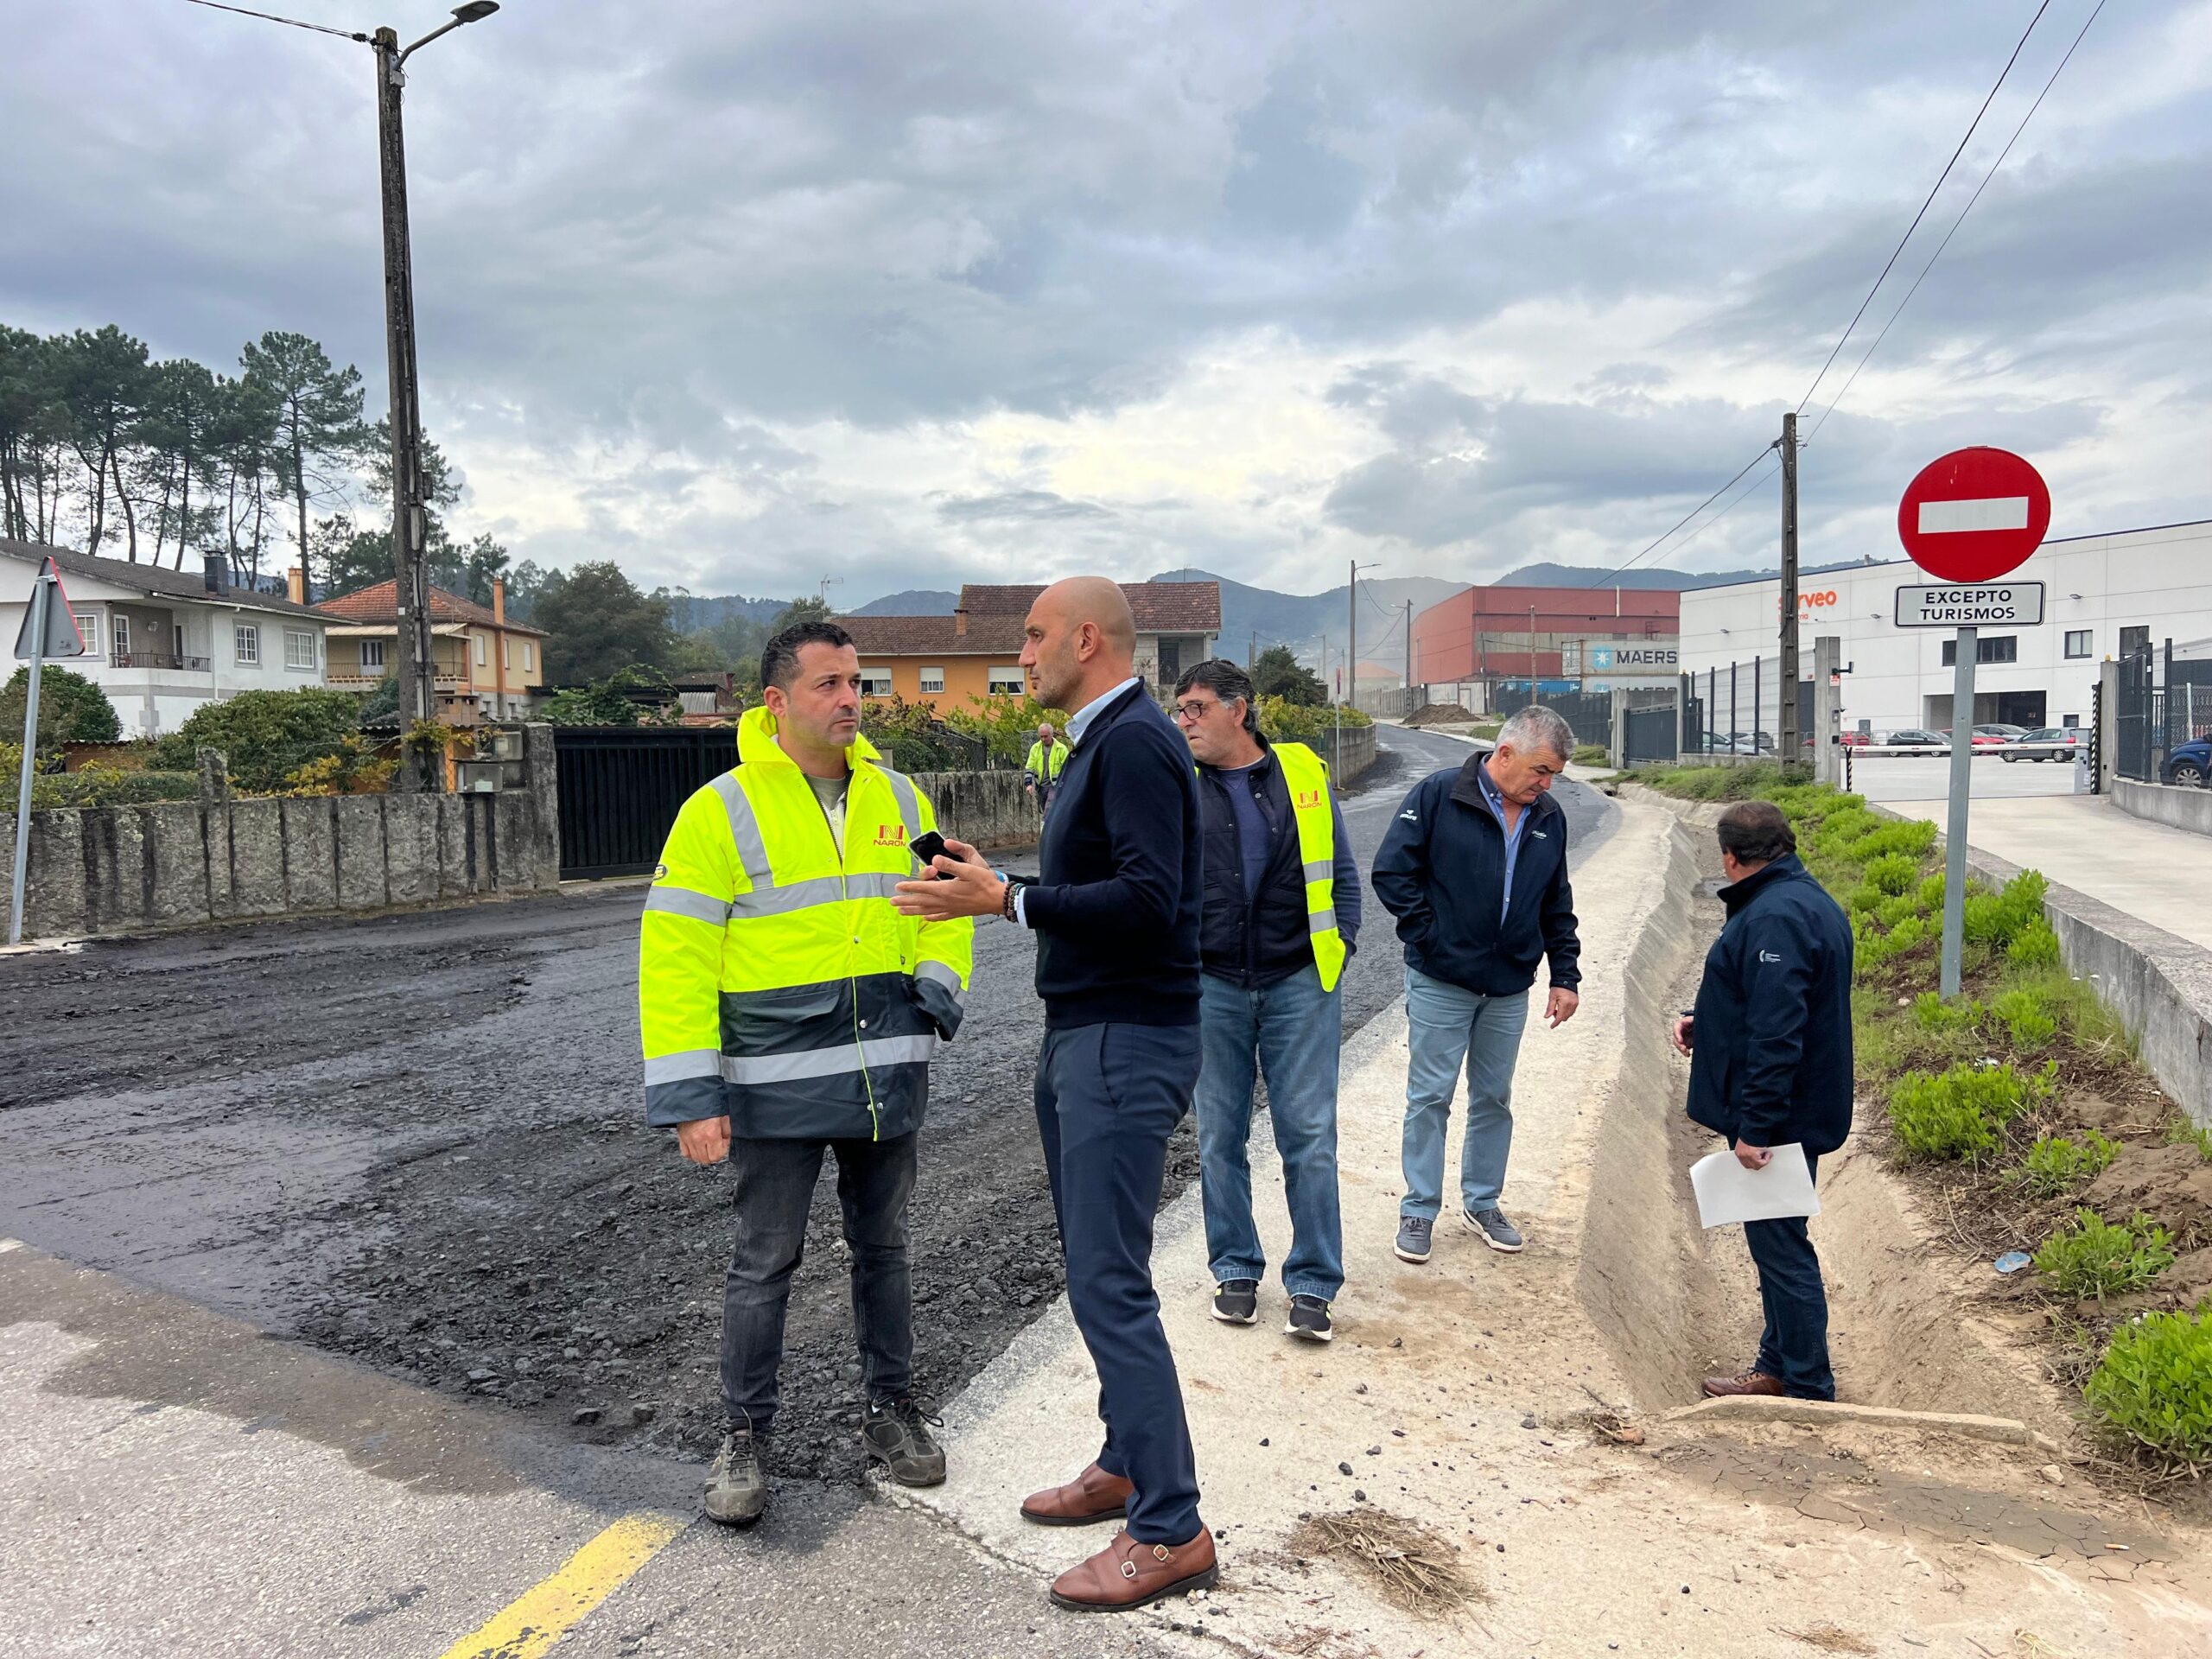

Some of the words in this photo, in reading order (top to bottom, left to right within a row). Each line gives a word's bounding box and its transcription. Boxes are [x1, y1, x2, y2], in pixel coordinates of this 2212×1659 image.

[1777, 590, 1837, 610] rveo
[1925, 589, 2012, 604] EXCEPTO
[1920, 607, 2015, 620] TURISMOS
[1617, 650, 1678, 664] MAERS
